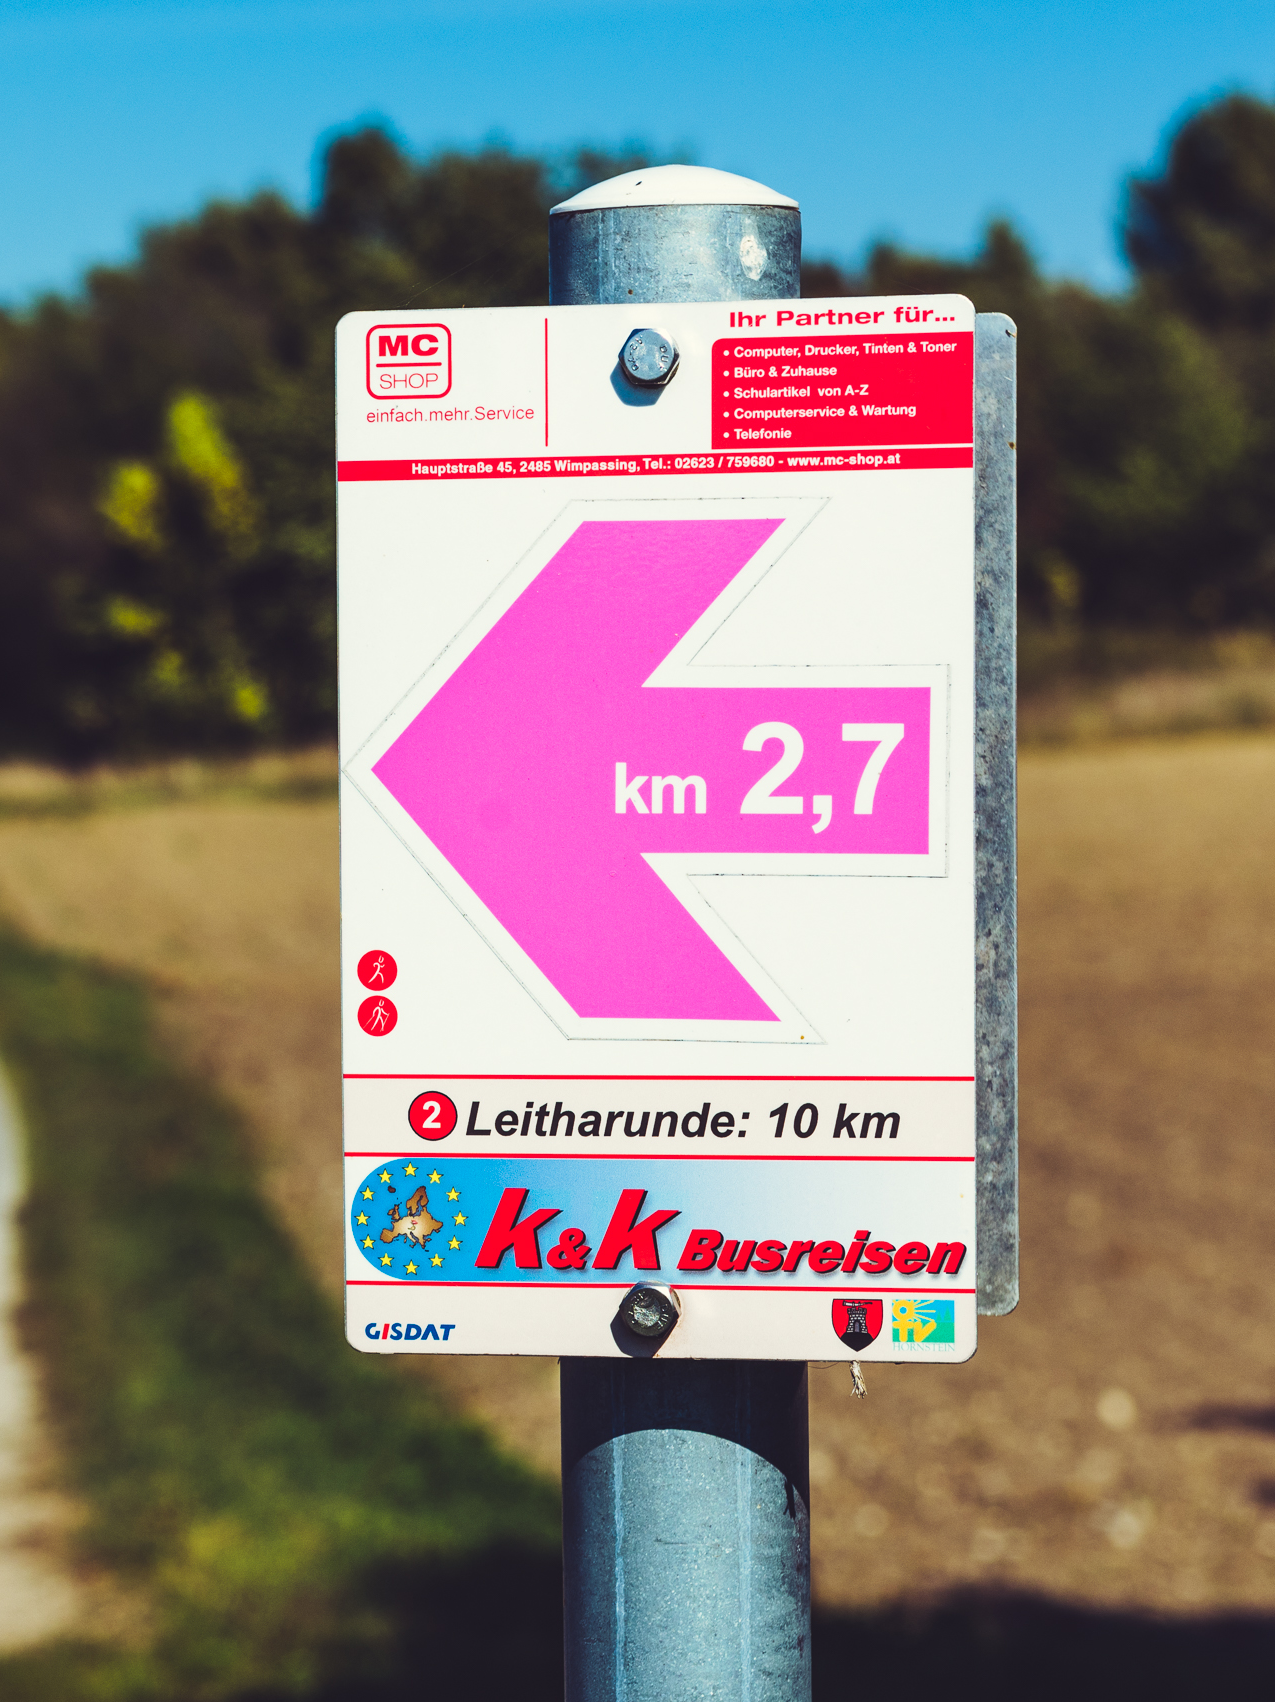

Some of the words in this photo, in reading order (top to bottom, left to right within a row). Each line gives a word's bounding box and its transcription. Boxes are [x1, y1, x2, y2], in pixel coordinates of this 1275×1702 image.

[729, 311, 767, 328] Ihr
[776, 309, 885, 327] Partner
[893, 306, 955, 323] für...
[379, 334, 438, 356] MC
[733, 345, 802, 360] Computer,
[804, 343, 860, 357] Drucker,
[862, 342, 904, 355] Tinten
[906, 341, 917, 354] &
[919, 341, 958, 353] Toner
[379, 372, 439, 390] SHOP
[734, 366, 766, 379] Büro
[768, 365, 778, 378] &
[781, 365, 838, 377] Zuhause
[733, 385, 811, 399] Schulartikel
[817, 387, 842, 397] von
[844, 384, 869, 396] A-Z
[366, 405, 535, 424] einfach.mehr.Service
[733, 405, 846, 421] Computerservice
[848, 404, 859, 417] &
[861, 404, 917, 418] Wartung
[733, 427, 792, 440] Telefonie
[411, 461, 494, 477] Hauptstraße
[496, 461, 517, 475] 45,
[519, 460, 552, 473] 2485
[553, 458, 641, 474] Wimpassing,
[642, 457, 671, 470] Tel.:
[674, 456, 715, 469] 02623
[717, 456, 724, 468] /
[726, 455, 775, 468] 759680
[786, 452, 901, 468] www.mc-shop.at
[615, 762, 707, 814] km
[740, 721, 904, 834] 2,7
[423, 1101, 441, 1128] 2
[466, 1102, 749, 1137] Leitharunde:
[770, 1103, 818, 1138] 10
[833, 1104, 900, 1138] km
[676, 1229, 967, 1274] Busreisen
[364, 1322, 456, 1342] GISDAT
[892, 1342, 955, 1352] HORNSTEIN
